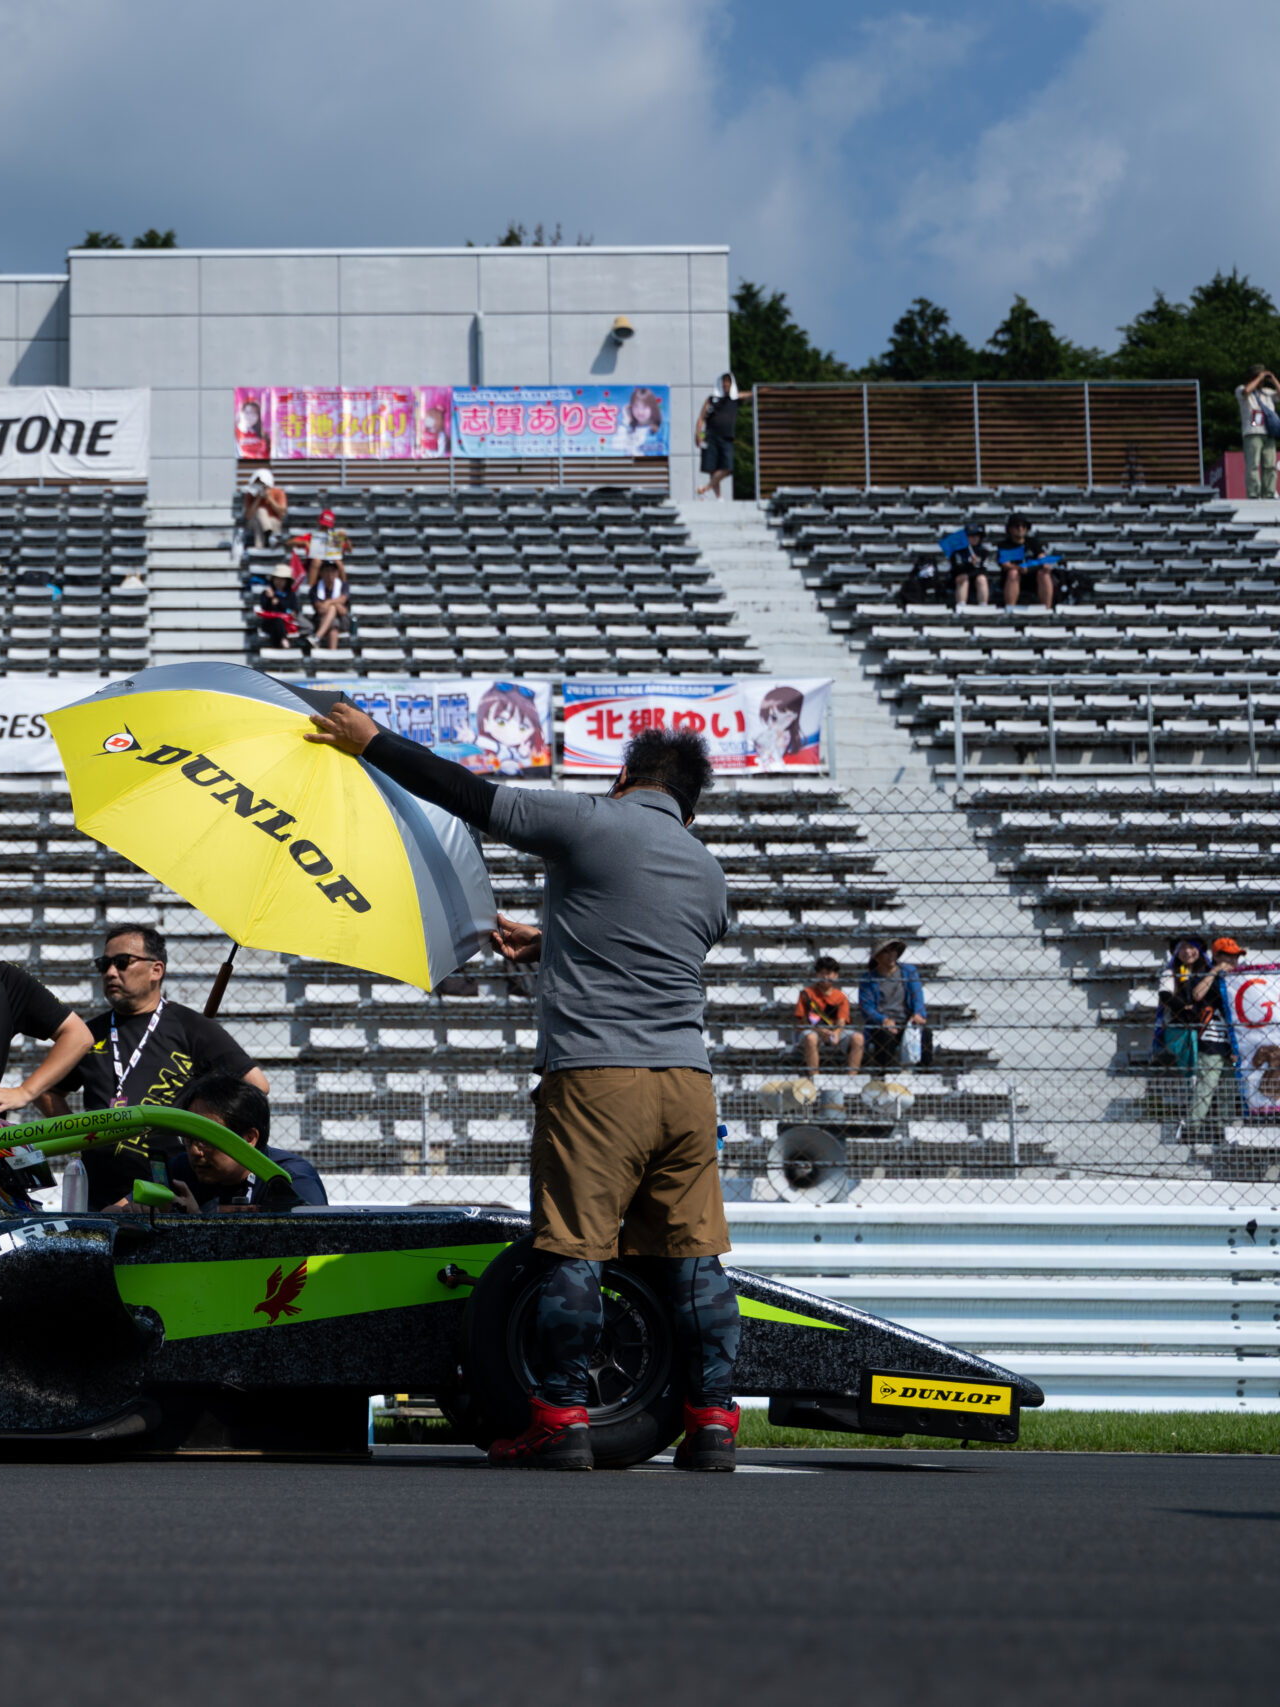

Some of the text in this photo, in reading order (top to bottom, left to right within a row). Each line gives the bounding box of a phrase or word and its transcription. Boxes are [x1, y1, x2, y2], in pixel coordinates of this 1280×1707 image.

[280, 412, 407, 439] 寺地みのり
[460, 404, 618, 435] 志賀ありさ
[586, 706, 746, 740] 北郷ゆい
[136, 744, 372, 914] DUNLOP
[1234, 978, 1280, 1029] G
[48, 1110, 133, 1134] MOTORSPORT
[898, 1386, 1002, 1406] DUNLOP
